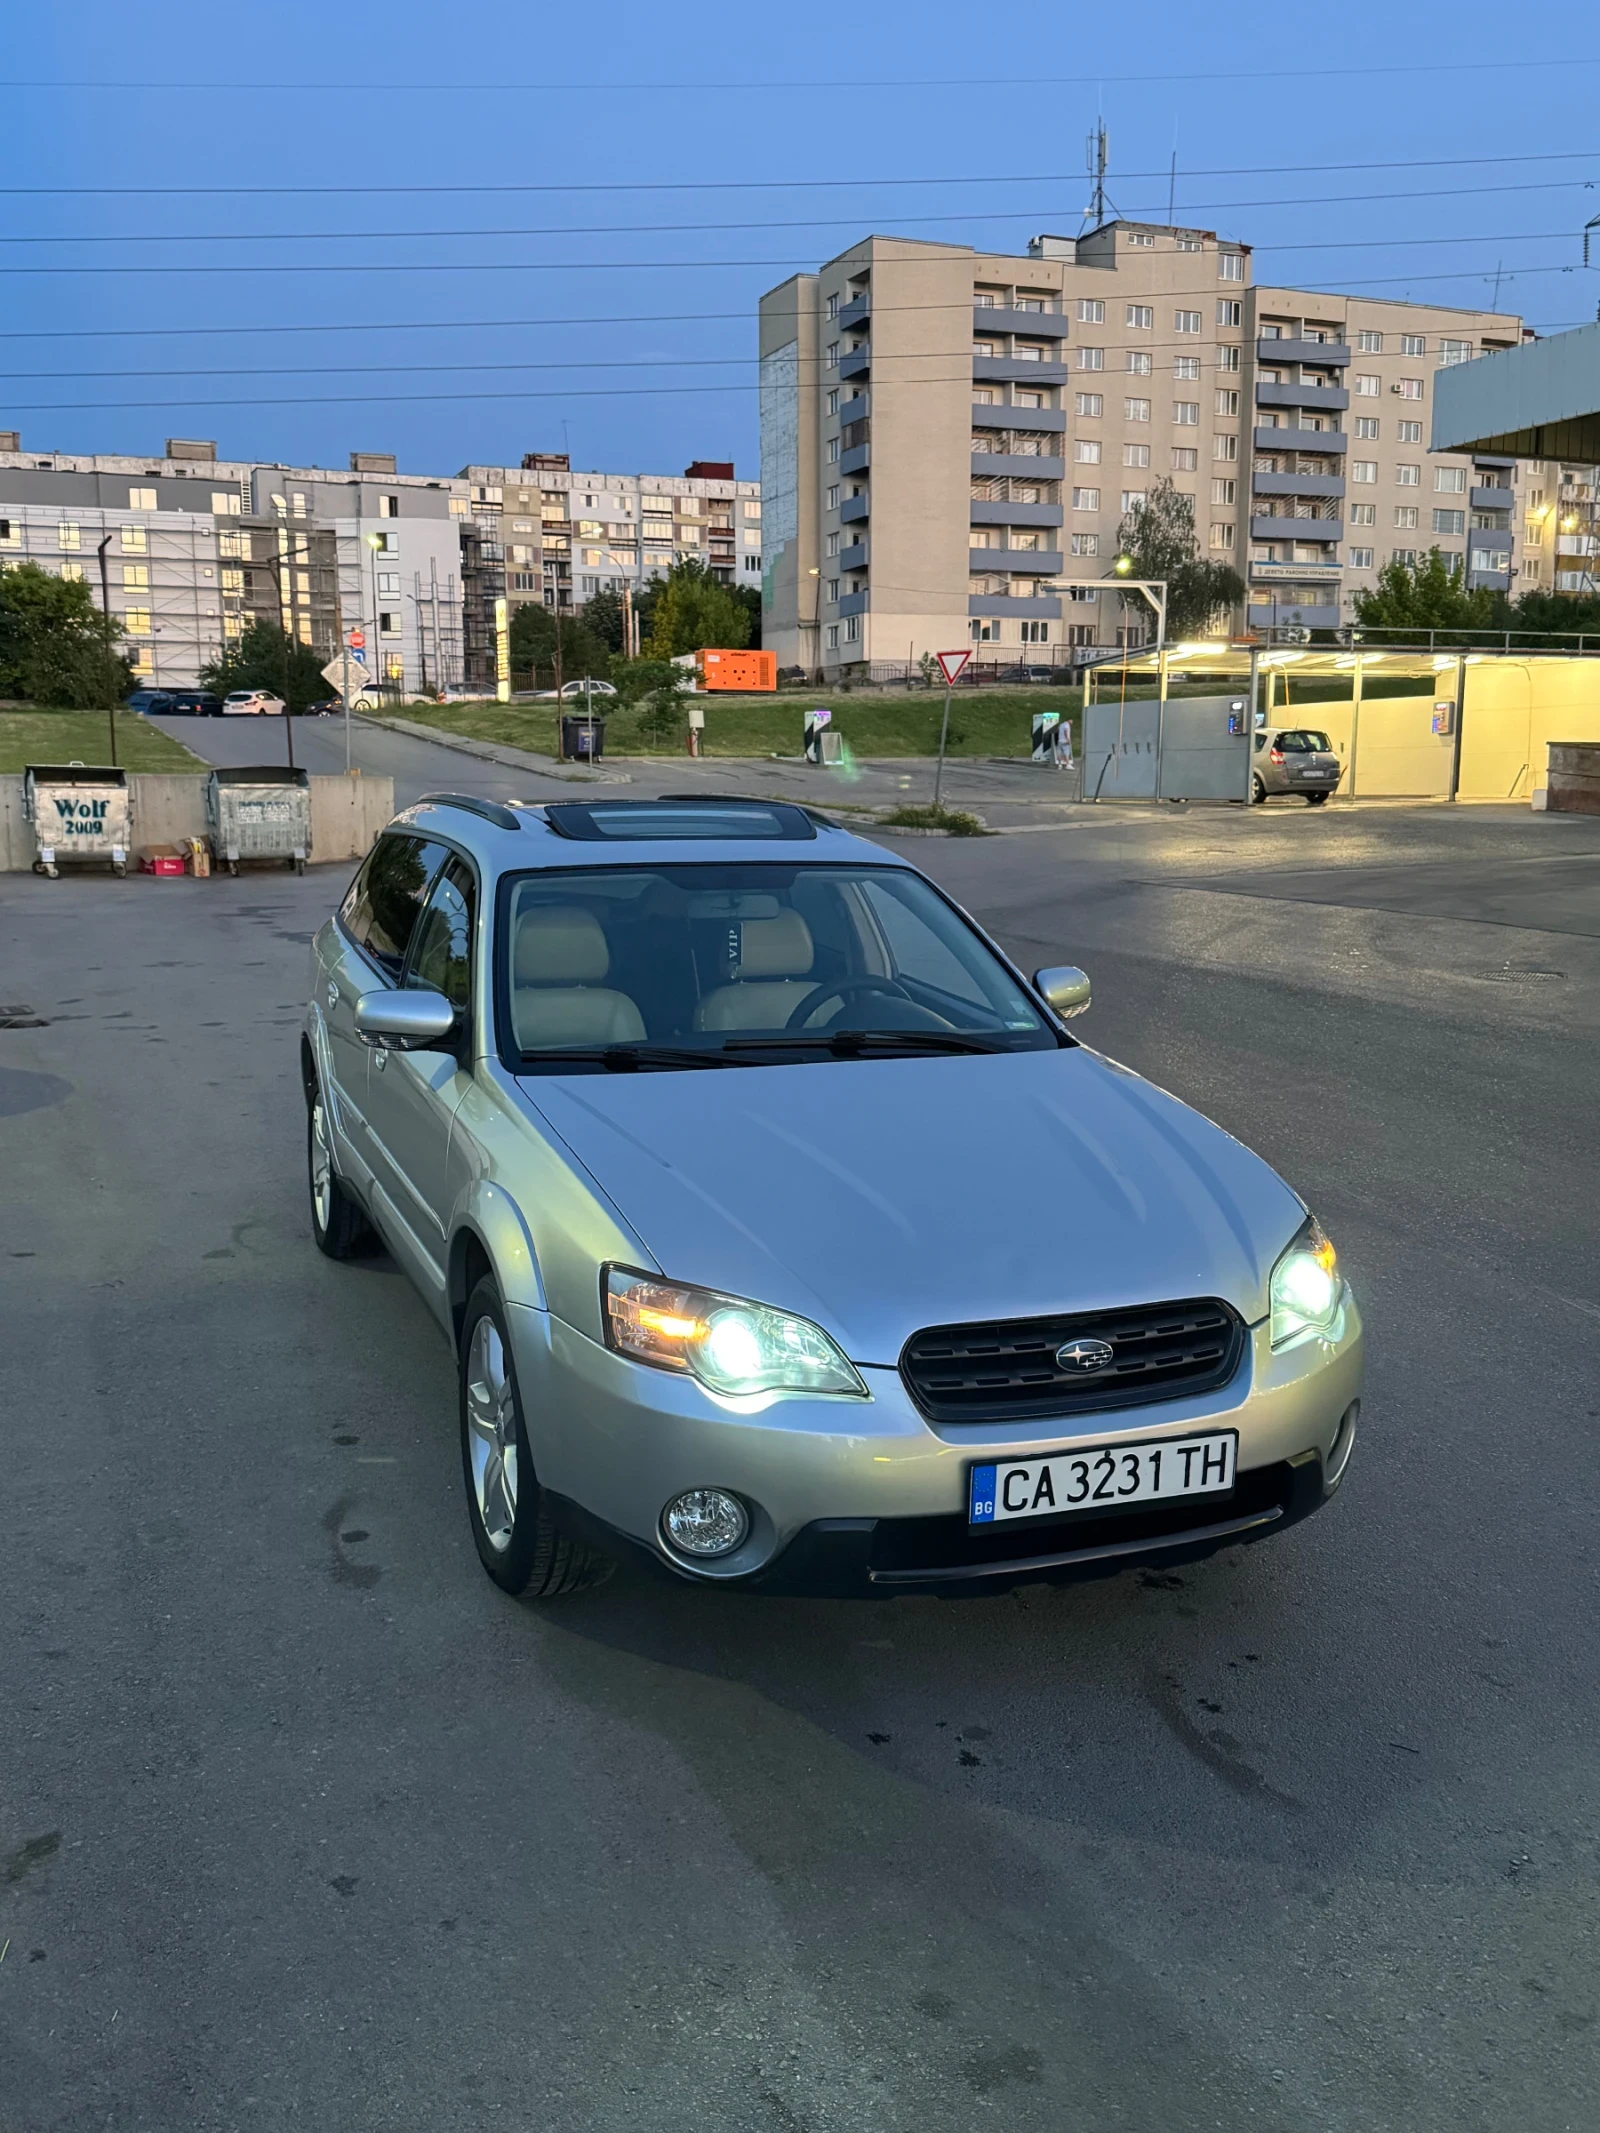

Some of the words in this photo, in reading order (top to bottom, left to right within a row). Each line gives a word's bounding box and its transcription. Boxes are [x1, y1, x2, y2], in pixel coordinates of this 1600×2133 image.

[53, 799, 111, 819] Wolf
[65, 820, 103, 835] 2009
[728, 929, 738, 959] VIP
[1002, 1465, 1056, 1512] CA
[1067, 1450, 1160, 1503] 3231
[1177, 1441, 1228, 1489] TH
[974, 1501, 993, 1516] BG
